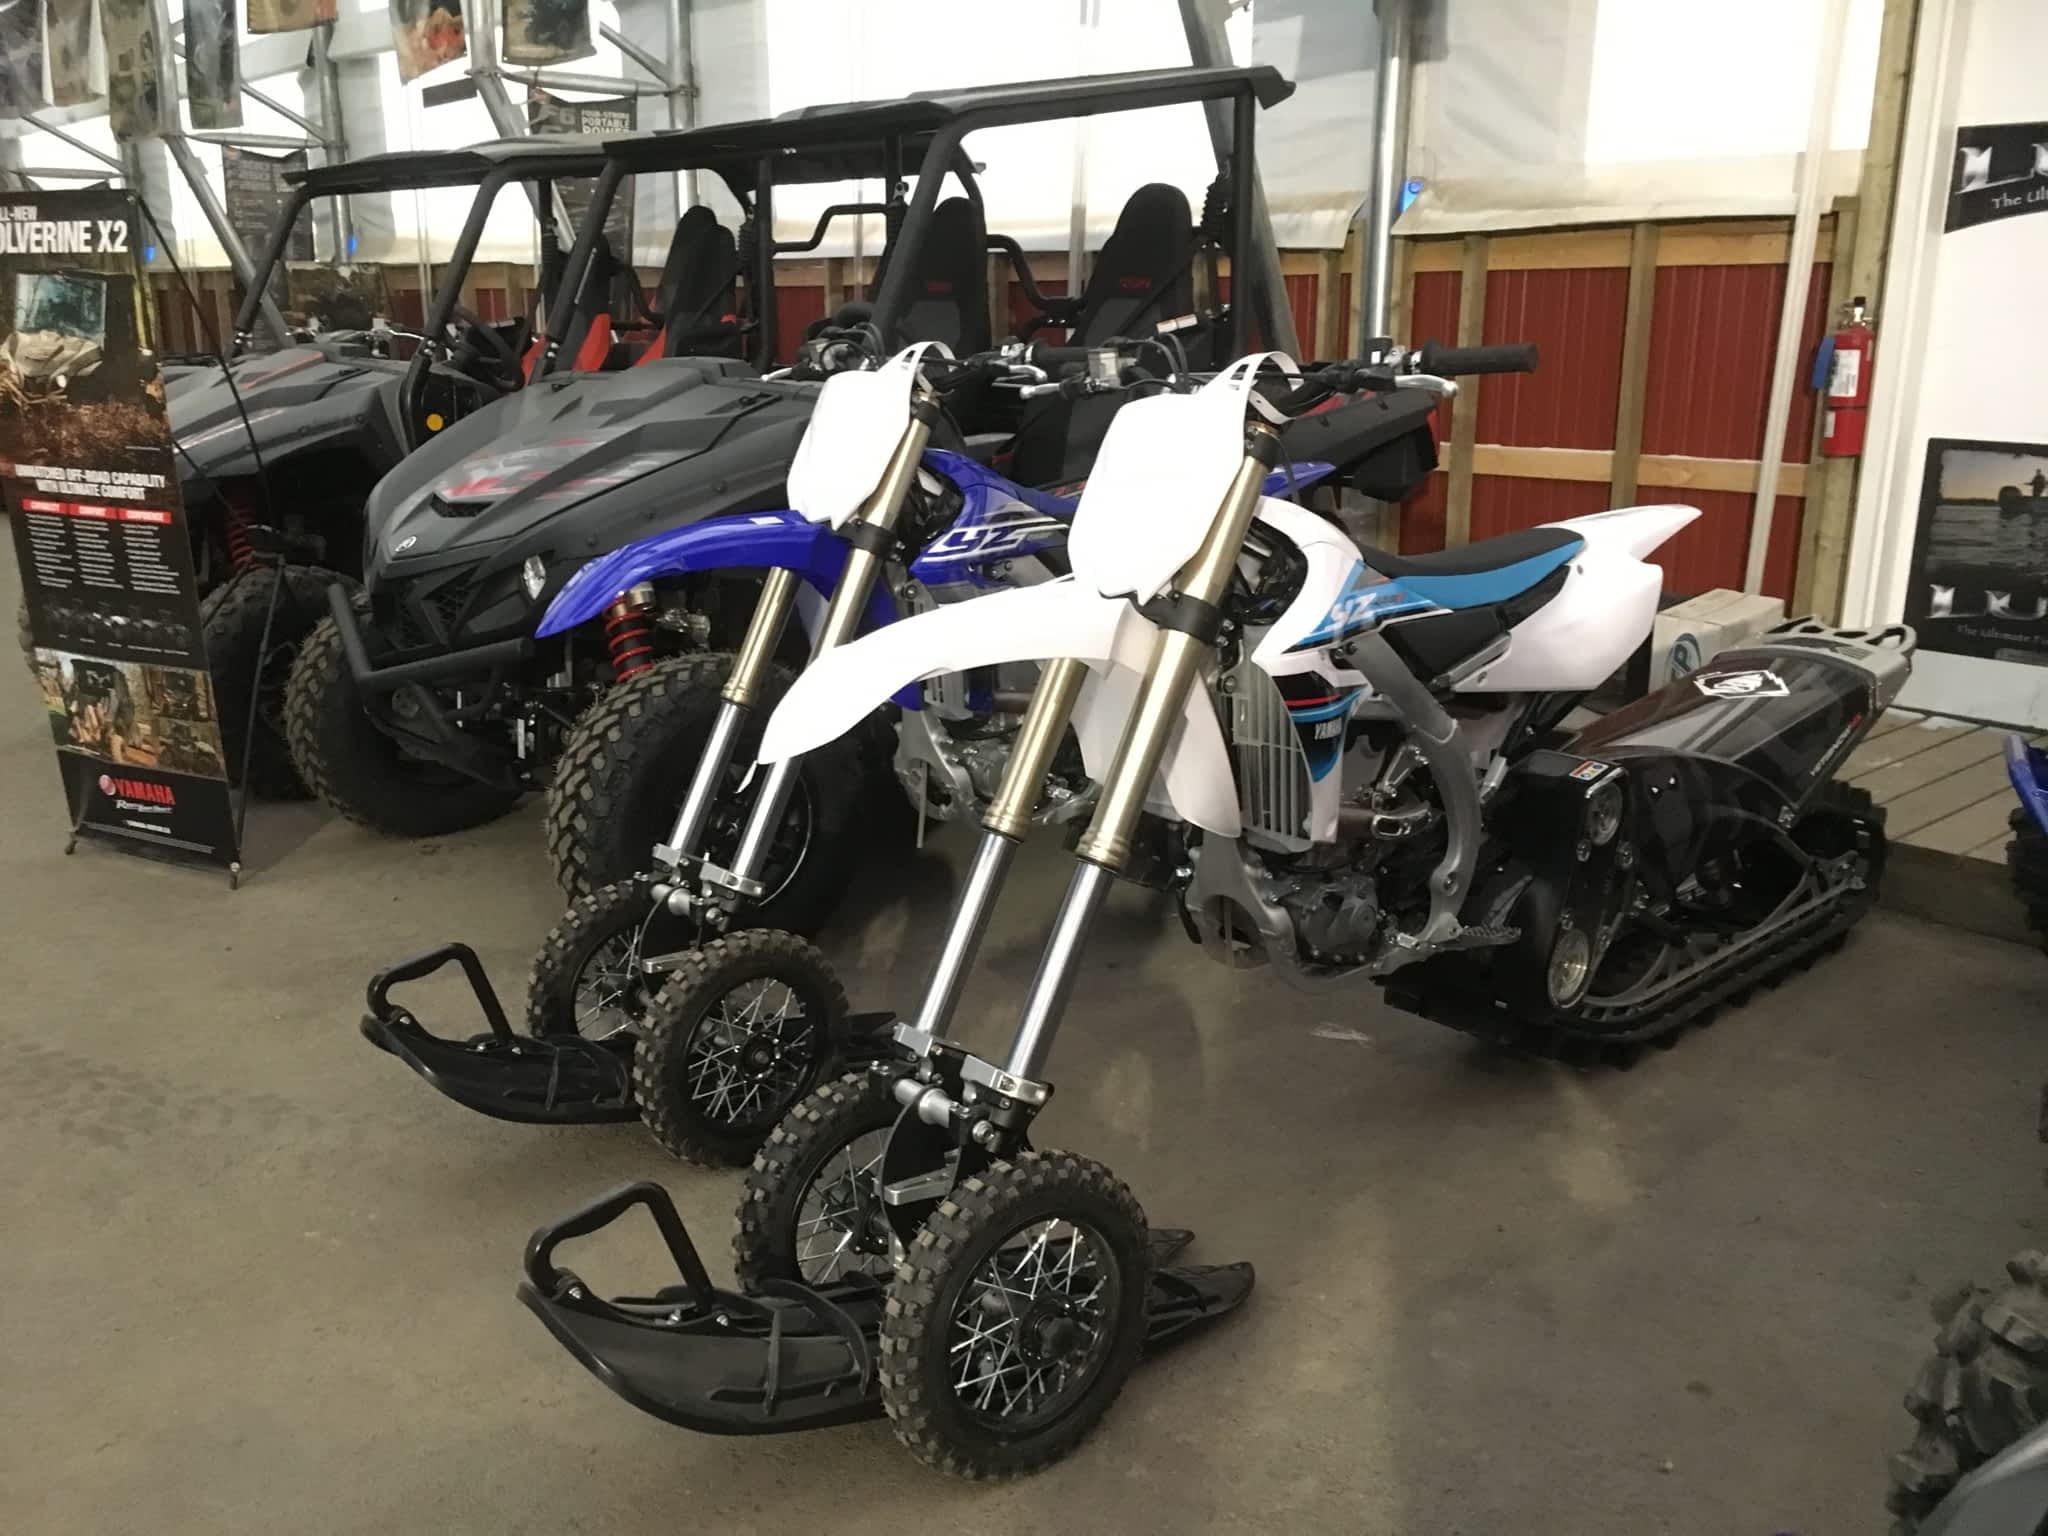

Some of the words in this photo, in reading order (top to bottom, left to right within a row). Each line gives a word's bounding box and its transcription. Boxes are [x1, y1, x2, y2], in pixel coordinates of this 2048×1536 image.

[581, 117, 630, 128] PORTABLE
[1991, 191, 2022, 209] The
[97, 220, 128, 253] X2
[112, 778, 176, 806] YAMAHA
